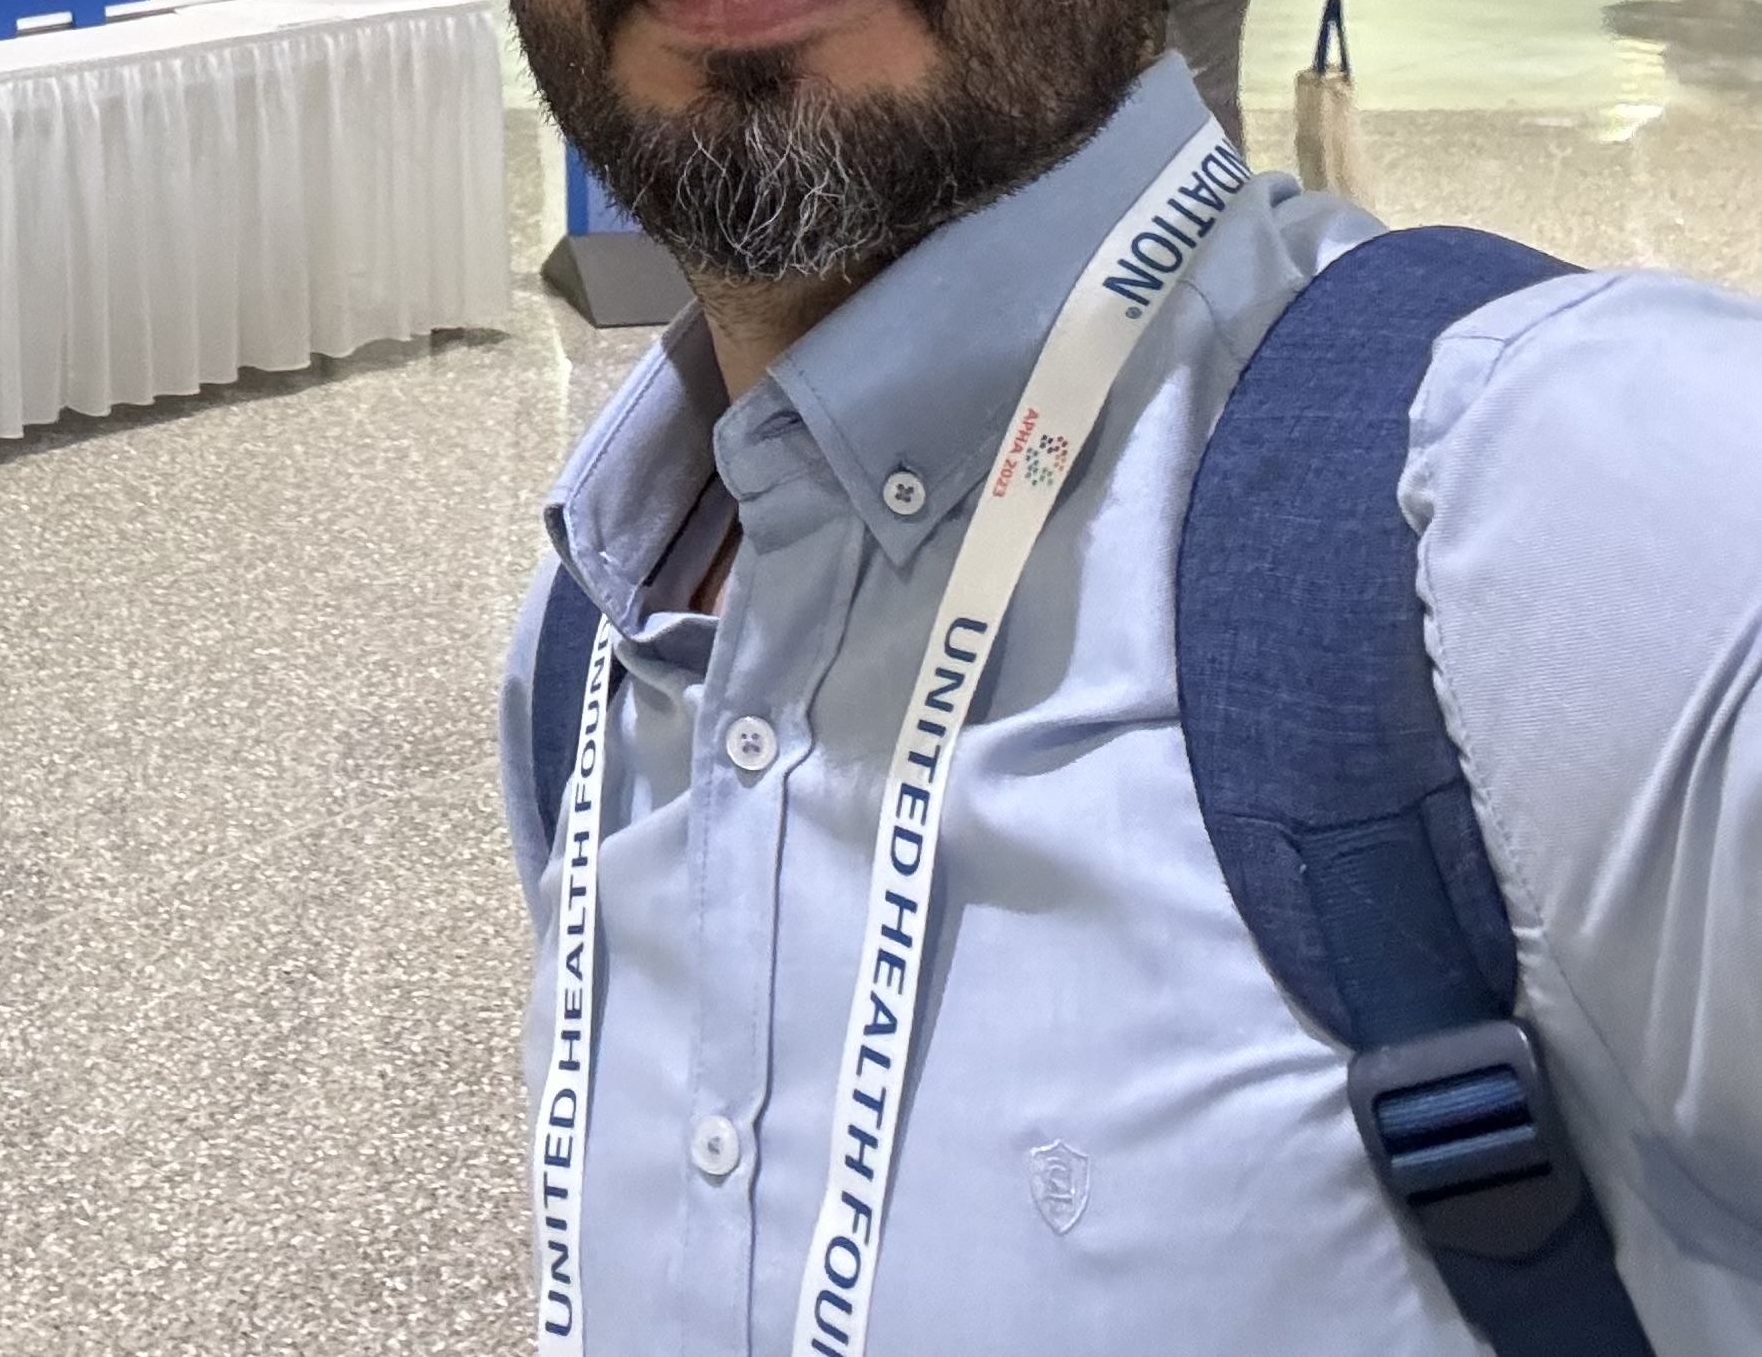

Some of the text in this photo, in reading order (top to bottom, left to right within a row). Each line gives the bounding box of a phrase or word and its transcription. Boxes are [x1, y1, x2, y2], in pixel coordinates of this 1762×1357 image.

[992, 408, 1039, 497] APHA 2023
[558, 830, 591, 1072] HEALTH
[810, 616, 989, 1357] UNITED HEALTH FOU
[543, 1087, 578, 1338] UNITED
